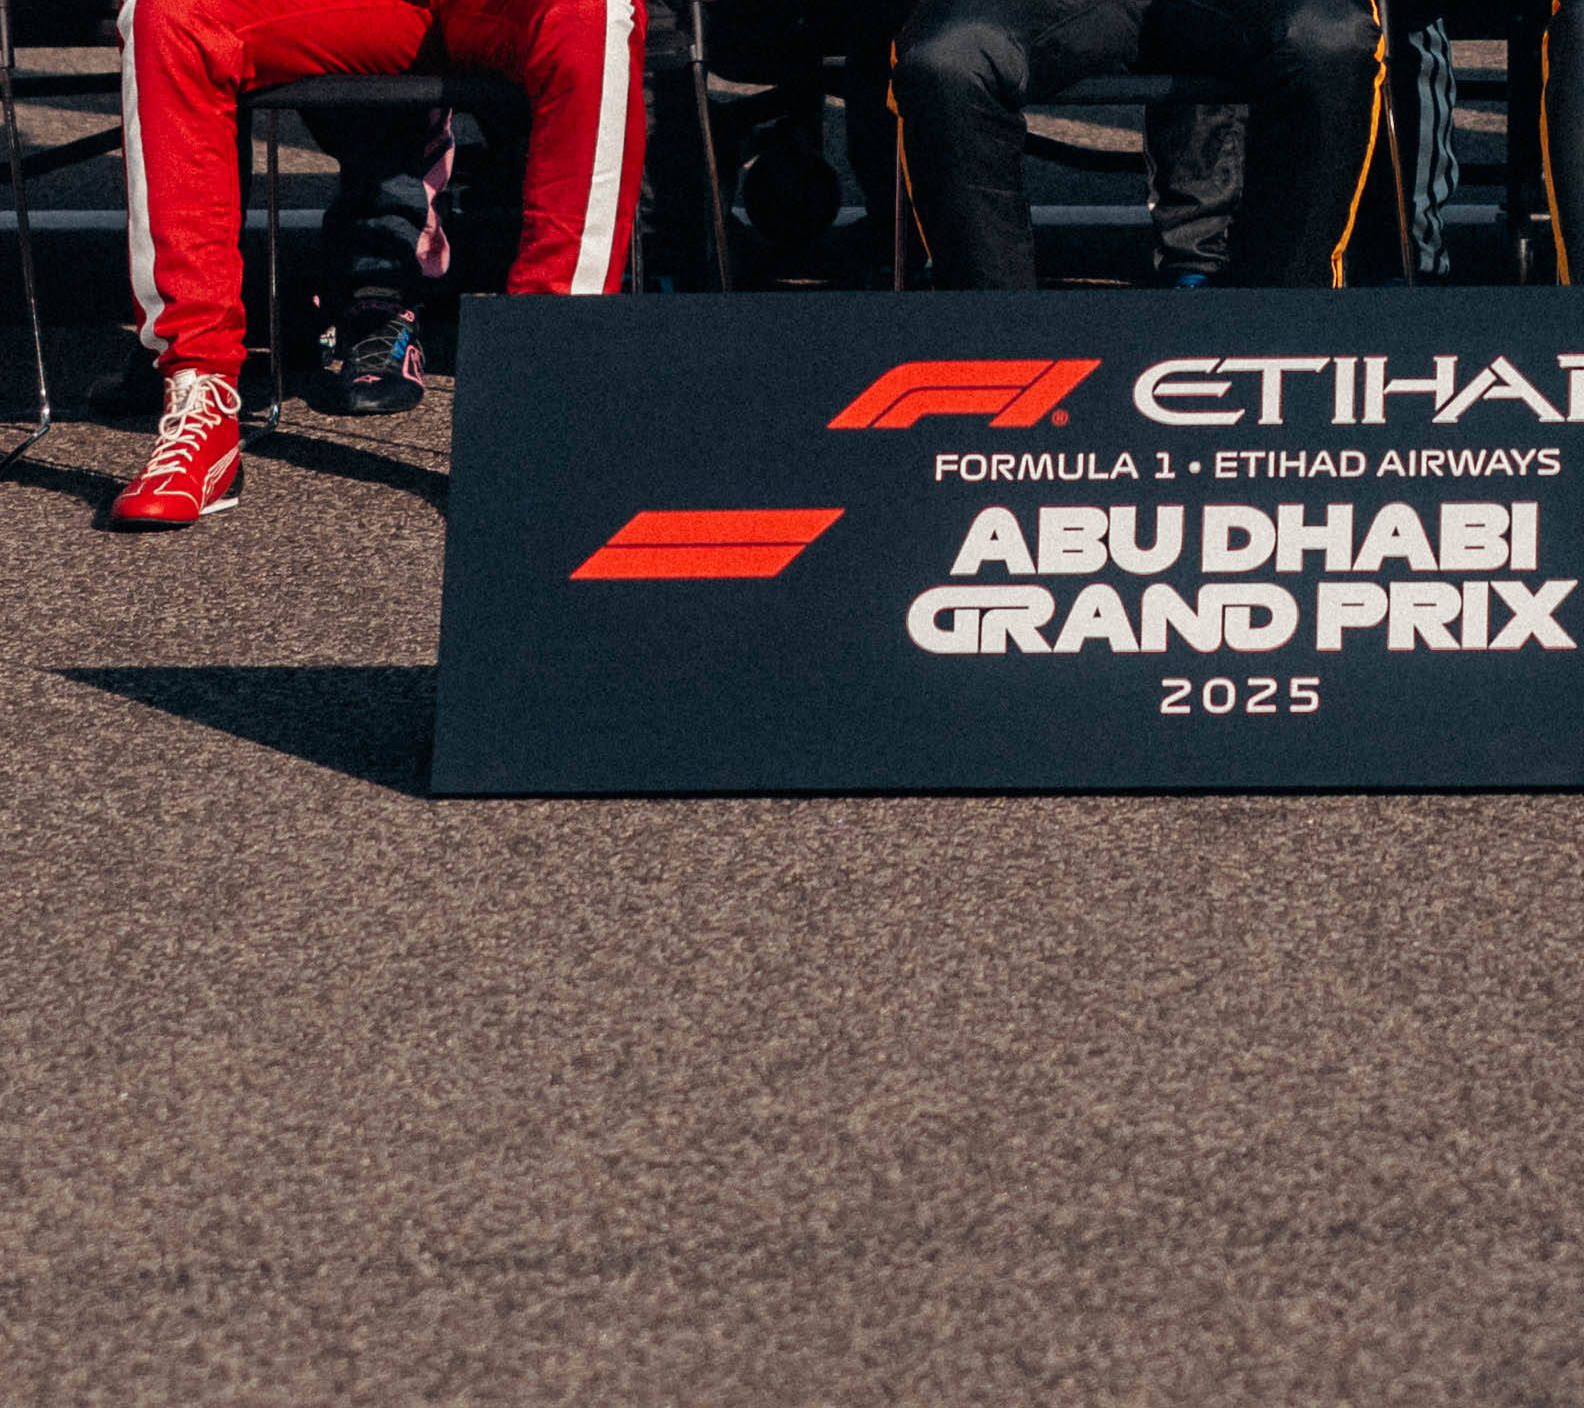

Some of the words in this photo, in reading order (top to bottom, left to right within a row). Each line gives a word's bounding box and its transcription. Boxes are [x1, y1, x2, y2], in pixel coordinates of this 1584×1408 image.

[936, 451, 1142, 481] FORMULA
[1155, 451, 1173, 481] 1
[1214, 451, 1366, 481] ETIHAD
[1377, 449, 1561, 480] AIRWAYS
[952, 502, 1184, 574] ABU
[1204, 502, 1538, 574] DHABI
[907, 581, 1298, 654] GRAND
[1318, 581, 1576, 652] PRIX
[1160, 678, 1322, 715] 2025
